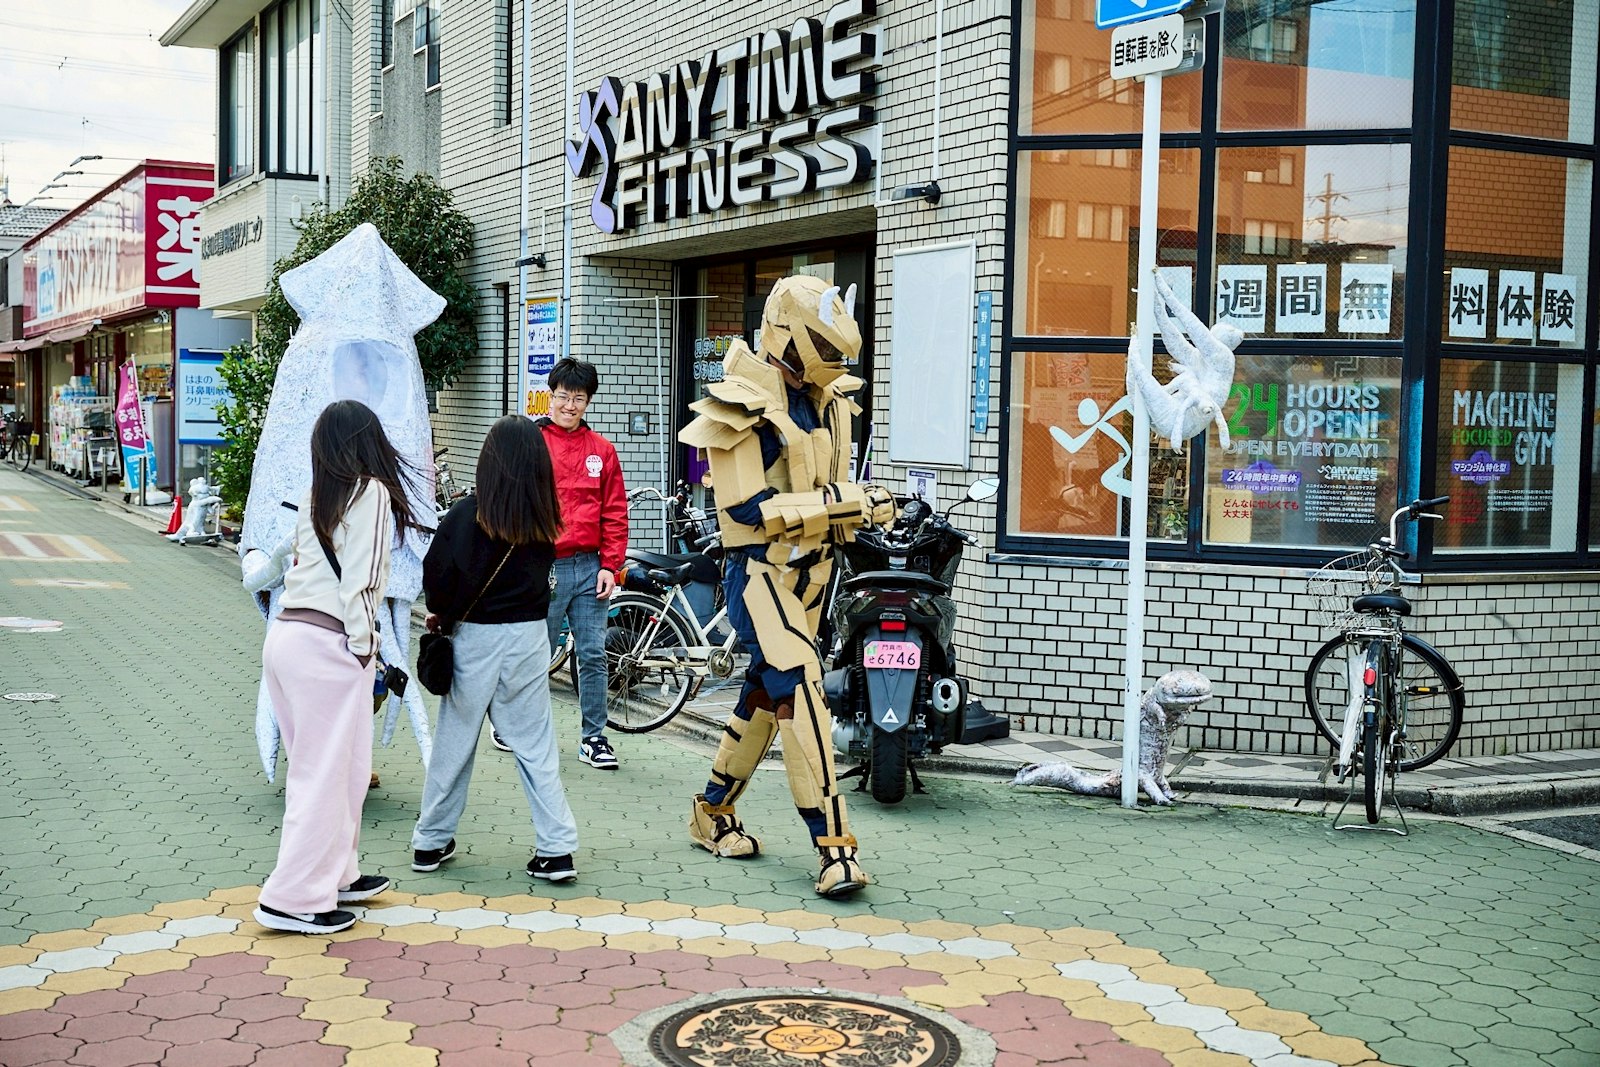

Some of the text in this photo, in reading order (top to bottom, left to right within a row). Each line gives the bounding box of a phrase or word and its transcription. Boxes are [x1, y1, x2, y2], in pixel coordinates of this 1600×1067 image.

[1114, 30, 1178, 67] 自転車を除く
[614, 0, 875, 162] ANYTIME
[615, 105, 873, 230] FITNESS
[185, 375, 213, 384] はまの
[1228, 383, 1380, 437] 24 HOURS
[1452, 390, 1556, 428] MACHINE
[1283, 409, 1379, 439] OPEN!
[1452, 428, 1513, 446] FOCUSED
[1224, 440, 1379, 459] OPEN EVERYDAY!
[1514, 431, 1556, 466] GYM
[1330, 466, 1378, 474] ANYTIME
[1454, 462, 1507, 472] マシンジム特化型
[1226, 471, 1298, 483] 24時間年中無休
[1330, 473, 1378, 481] FITNESS
[1223, 498, 1299, 510] どんなに忙しくても
[877, 652, 916, 666] 6746
